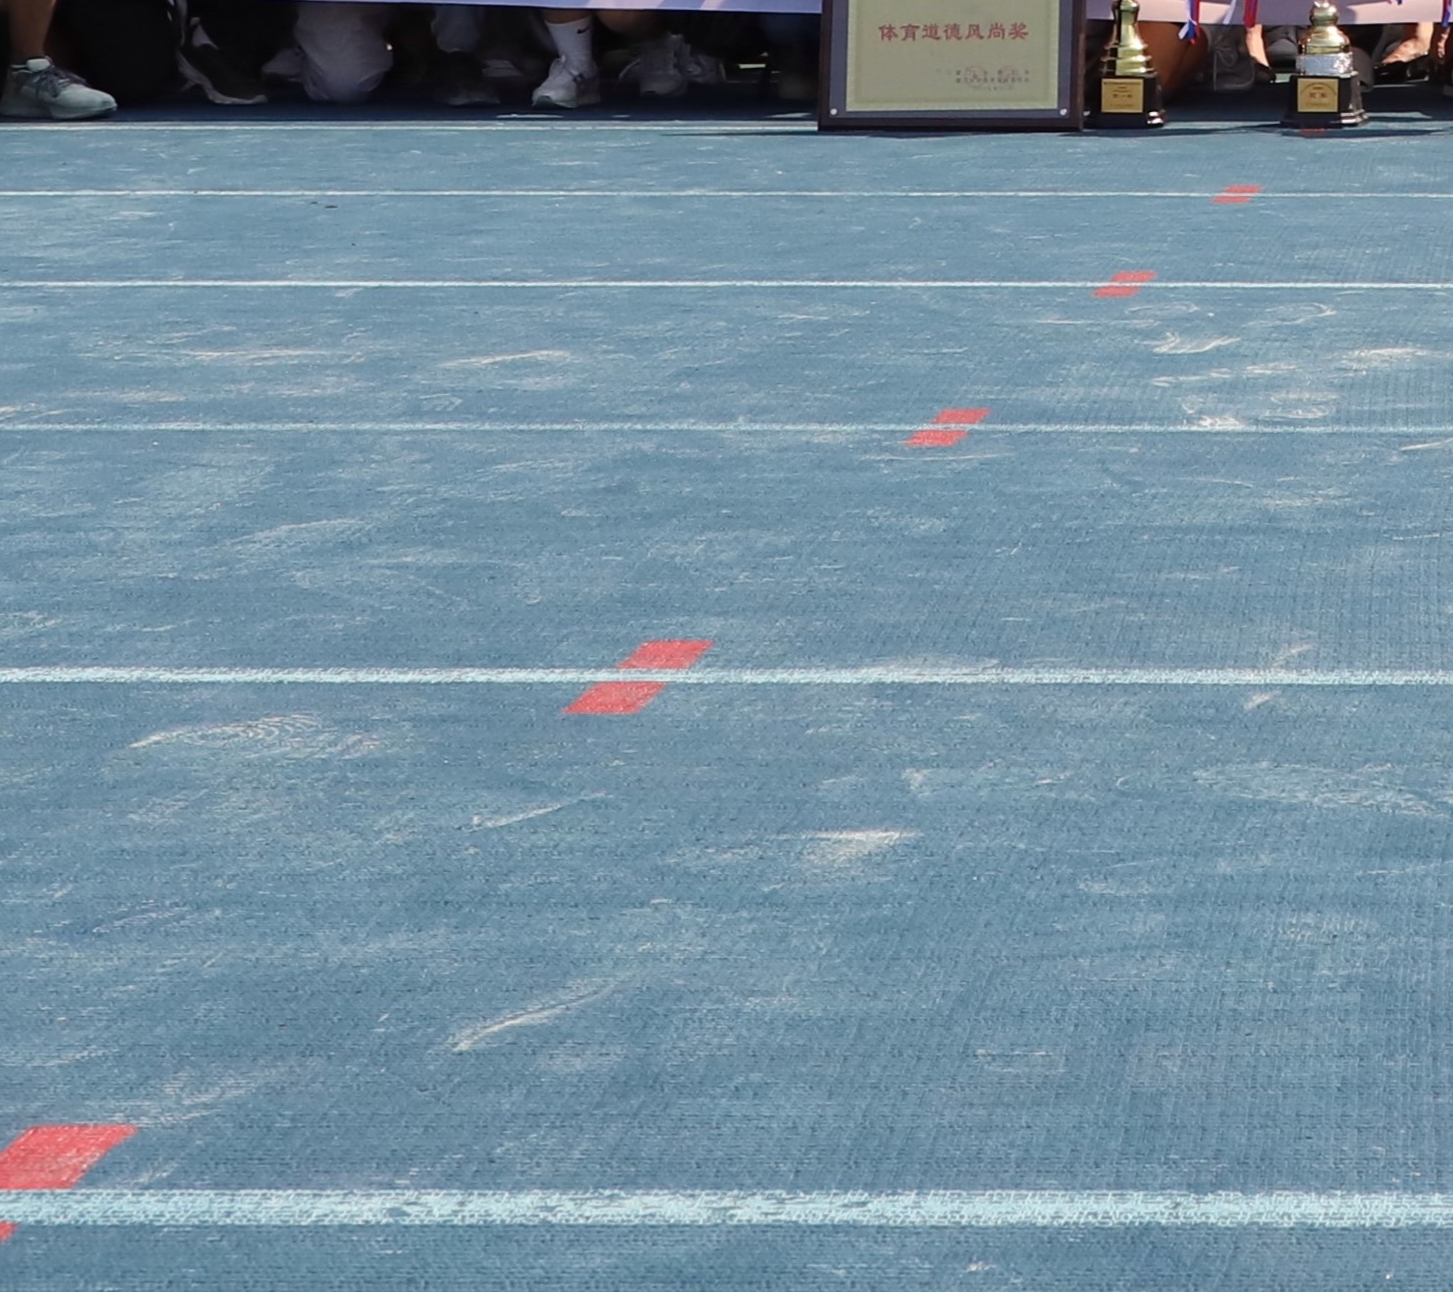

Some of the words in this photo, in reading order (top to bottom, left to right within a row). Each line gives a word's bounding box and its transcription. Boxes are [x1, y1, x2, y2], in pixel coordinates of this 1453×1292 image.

[878, 21, 1030, 42] 体育道德风尚奖
